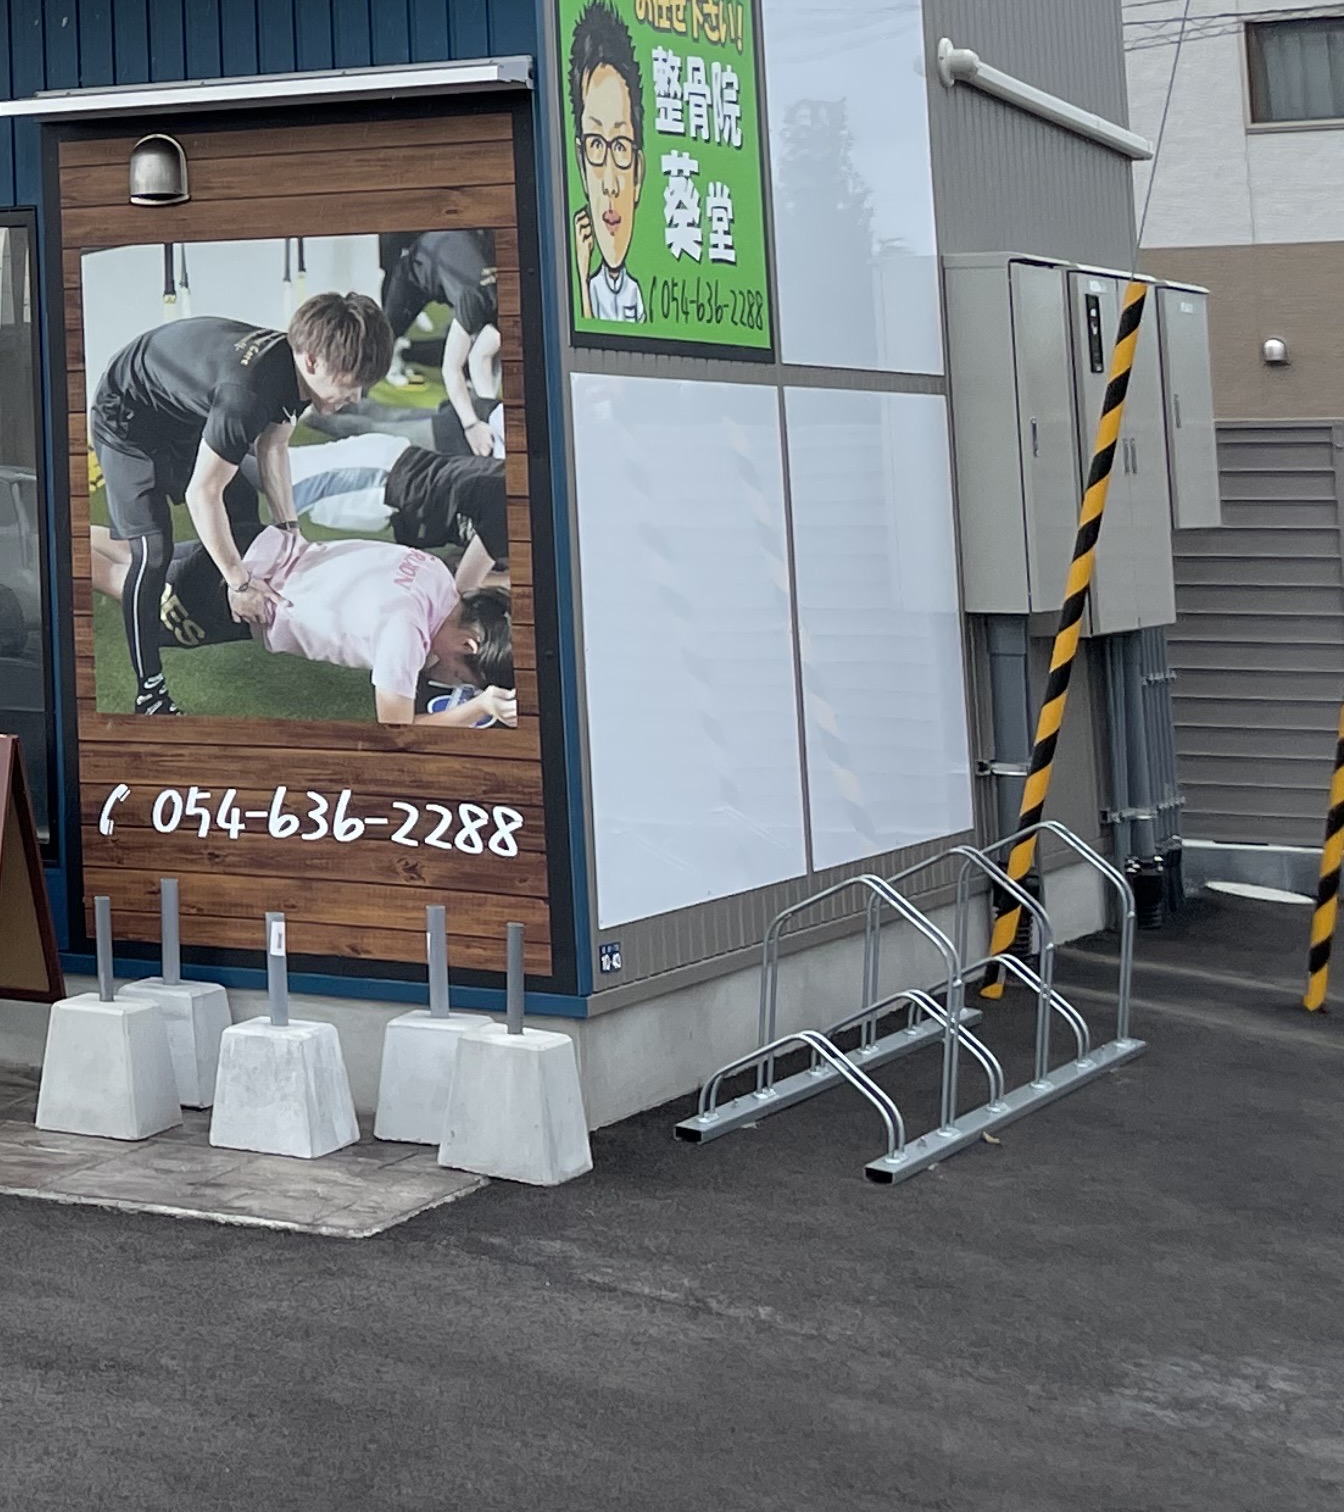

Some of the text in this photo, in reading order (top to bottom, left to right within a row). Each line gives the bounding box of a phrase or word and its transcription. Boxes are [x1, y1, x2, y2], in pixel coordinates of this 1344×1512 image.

[651, 45, 742, 148] 整骨院
[660, 149, 737, 264] 葵堂
[660, 275, 764, 331] 054-636-2288
[151, 785, 524, 858] 054-636-2288
